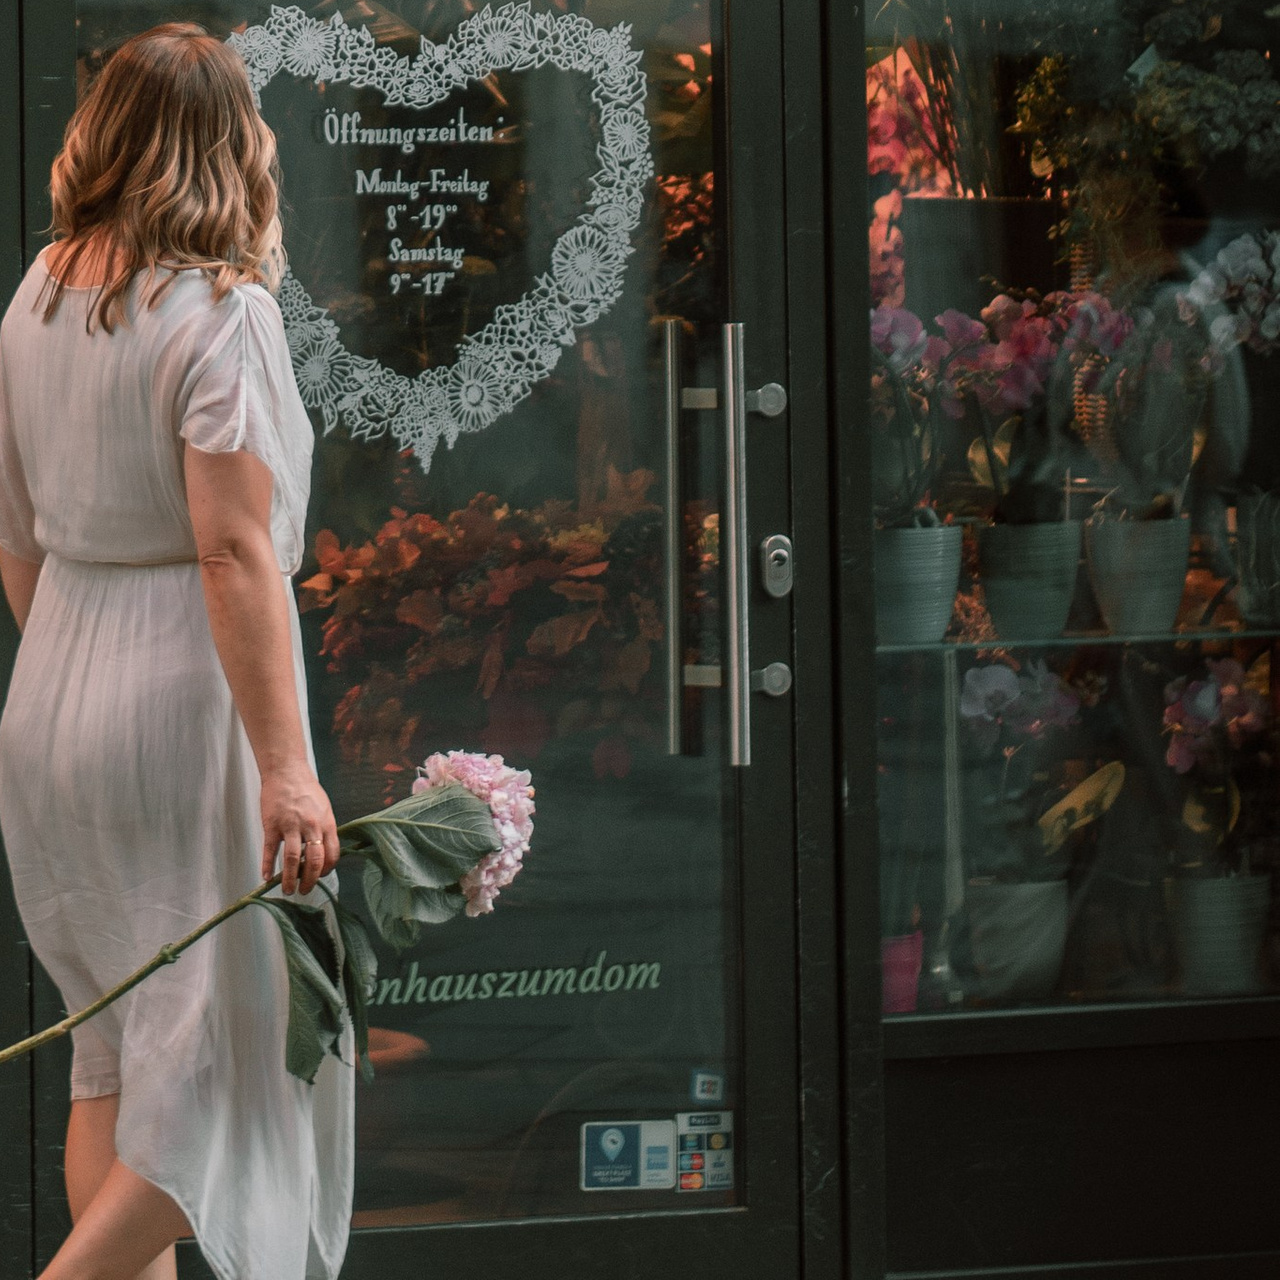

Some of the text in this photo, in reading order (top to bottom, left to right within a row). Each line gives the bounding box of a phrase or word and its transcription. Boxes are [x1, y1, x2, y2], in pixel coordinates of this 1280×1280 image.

[324, 107, 504, 153] Öffnungszeiten:
[355, 168, 489, 201] Montag-Freitag
[388, 236, 465, 269] Samstag
